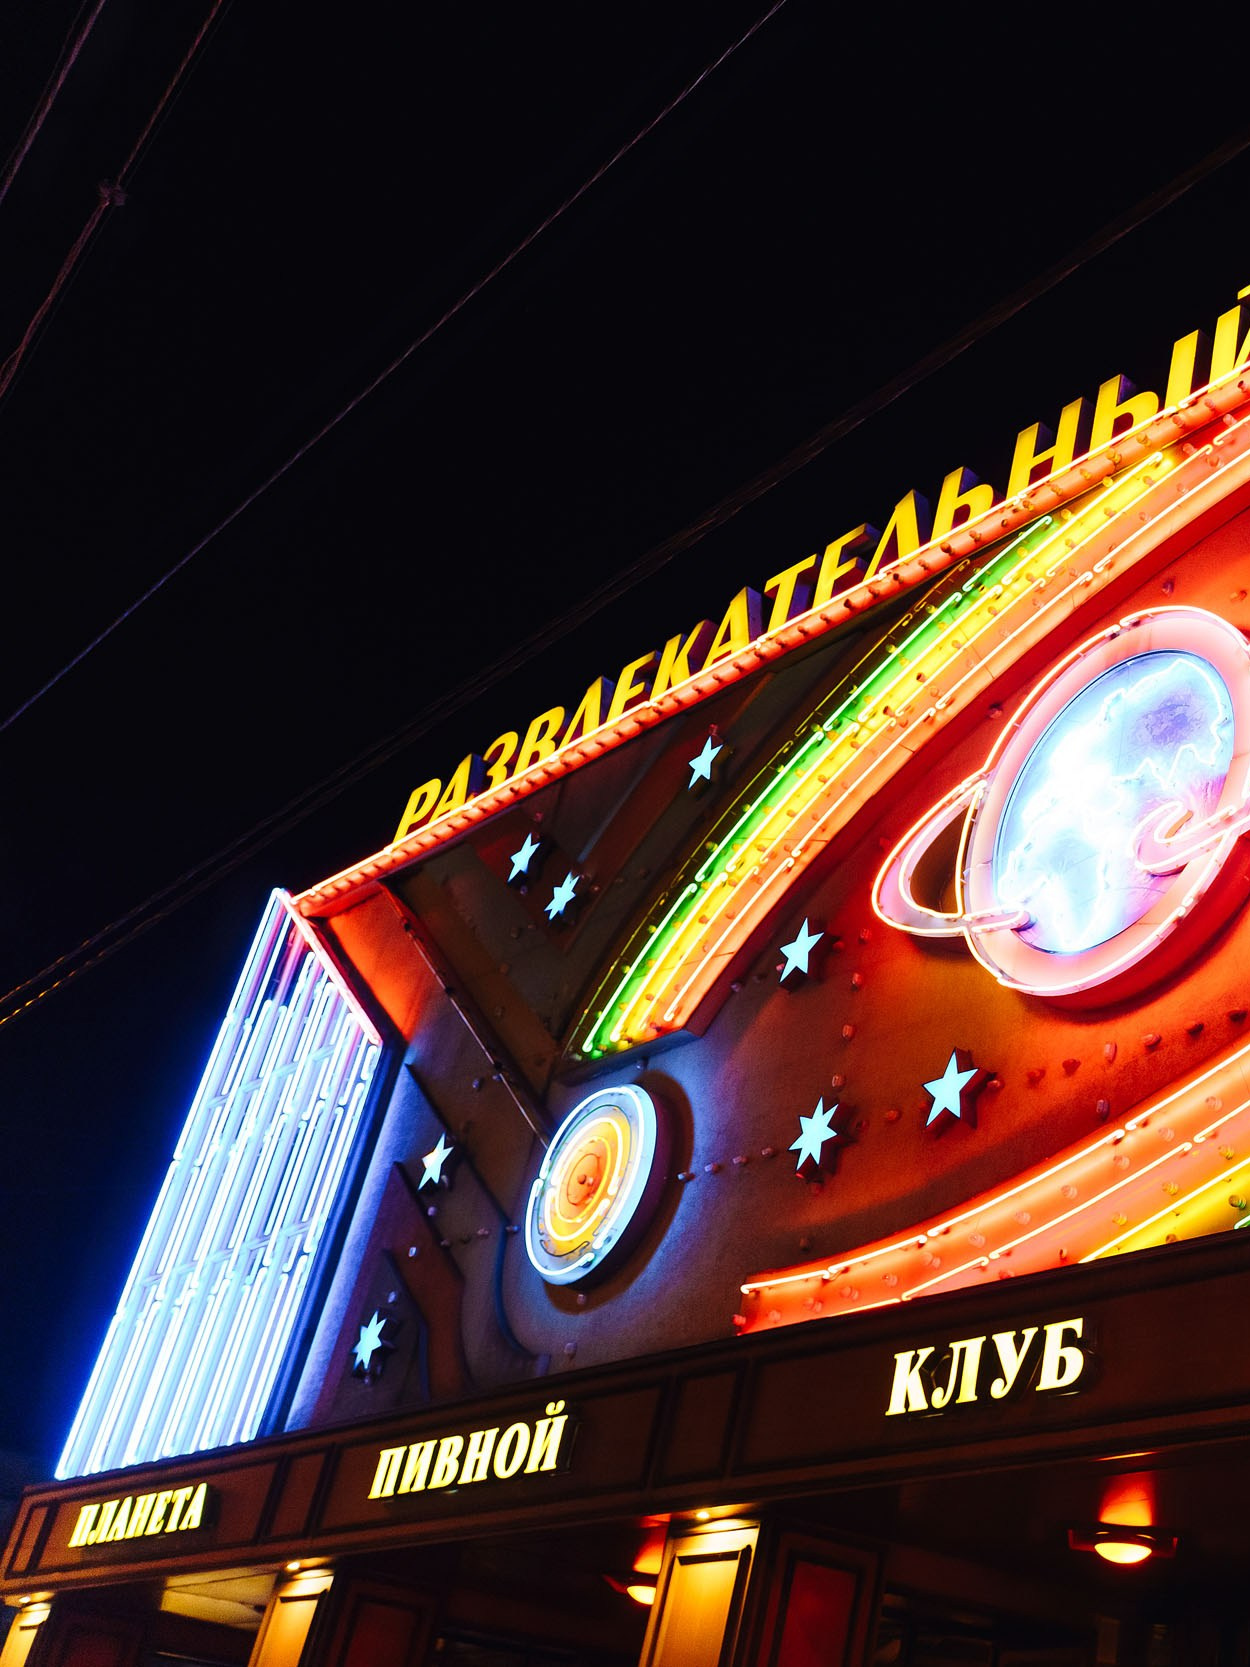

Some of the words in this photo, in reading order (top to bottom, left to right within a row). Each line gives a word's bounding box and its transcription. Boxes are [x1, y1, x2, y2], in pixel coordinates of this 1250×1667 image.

[68, 1483, 208, 1548] ПЛАНЕТА
[368, 1400, 568, 1499] ПИВНОЙ
[885, 1317, 1085, 1417] КЛУБ
